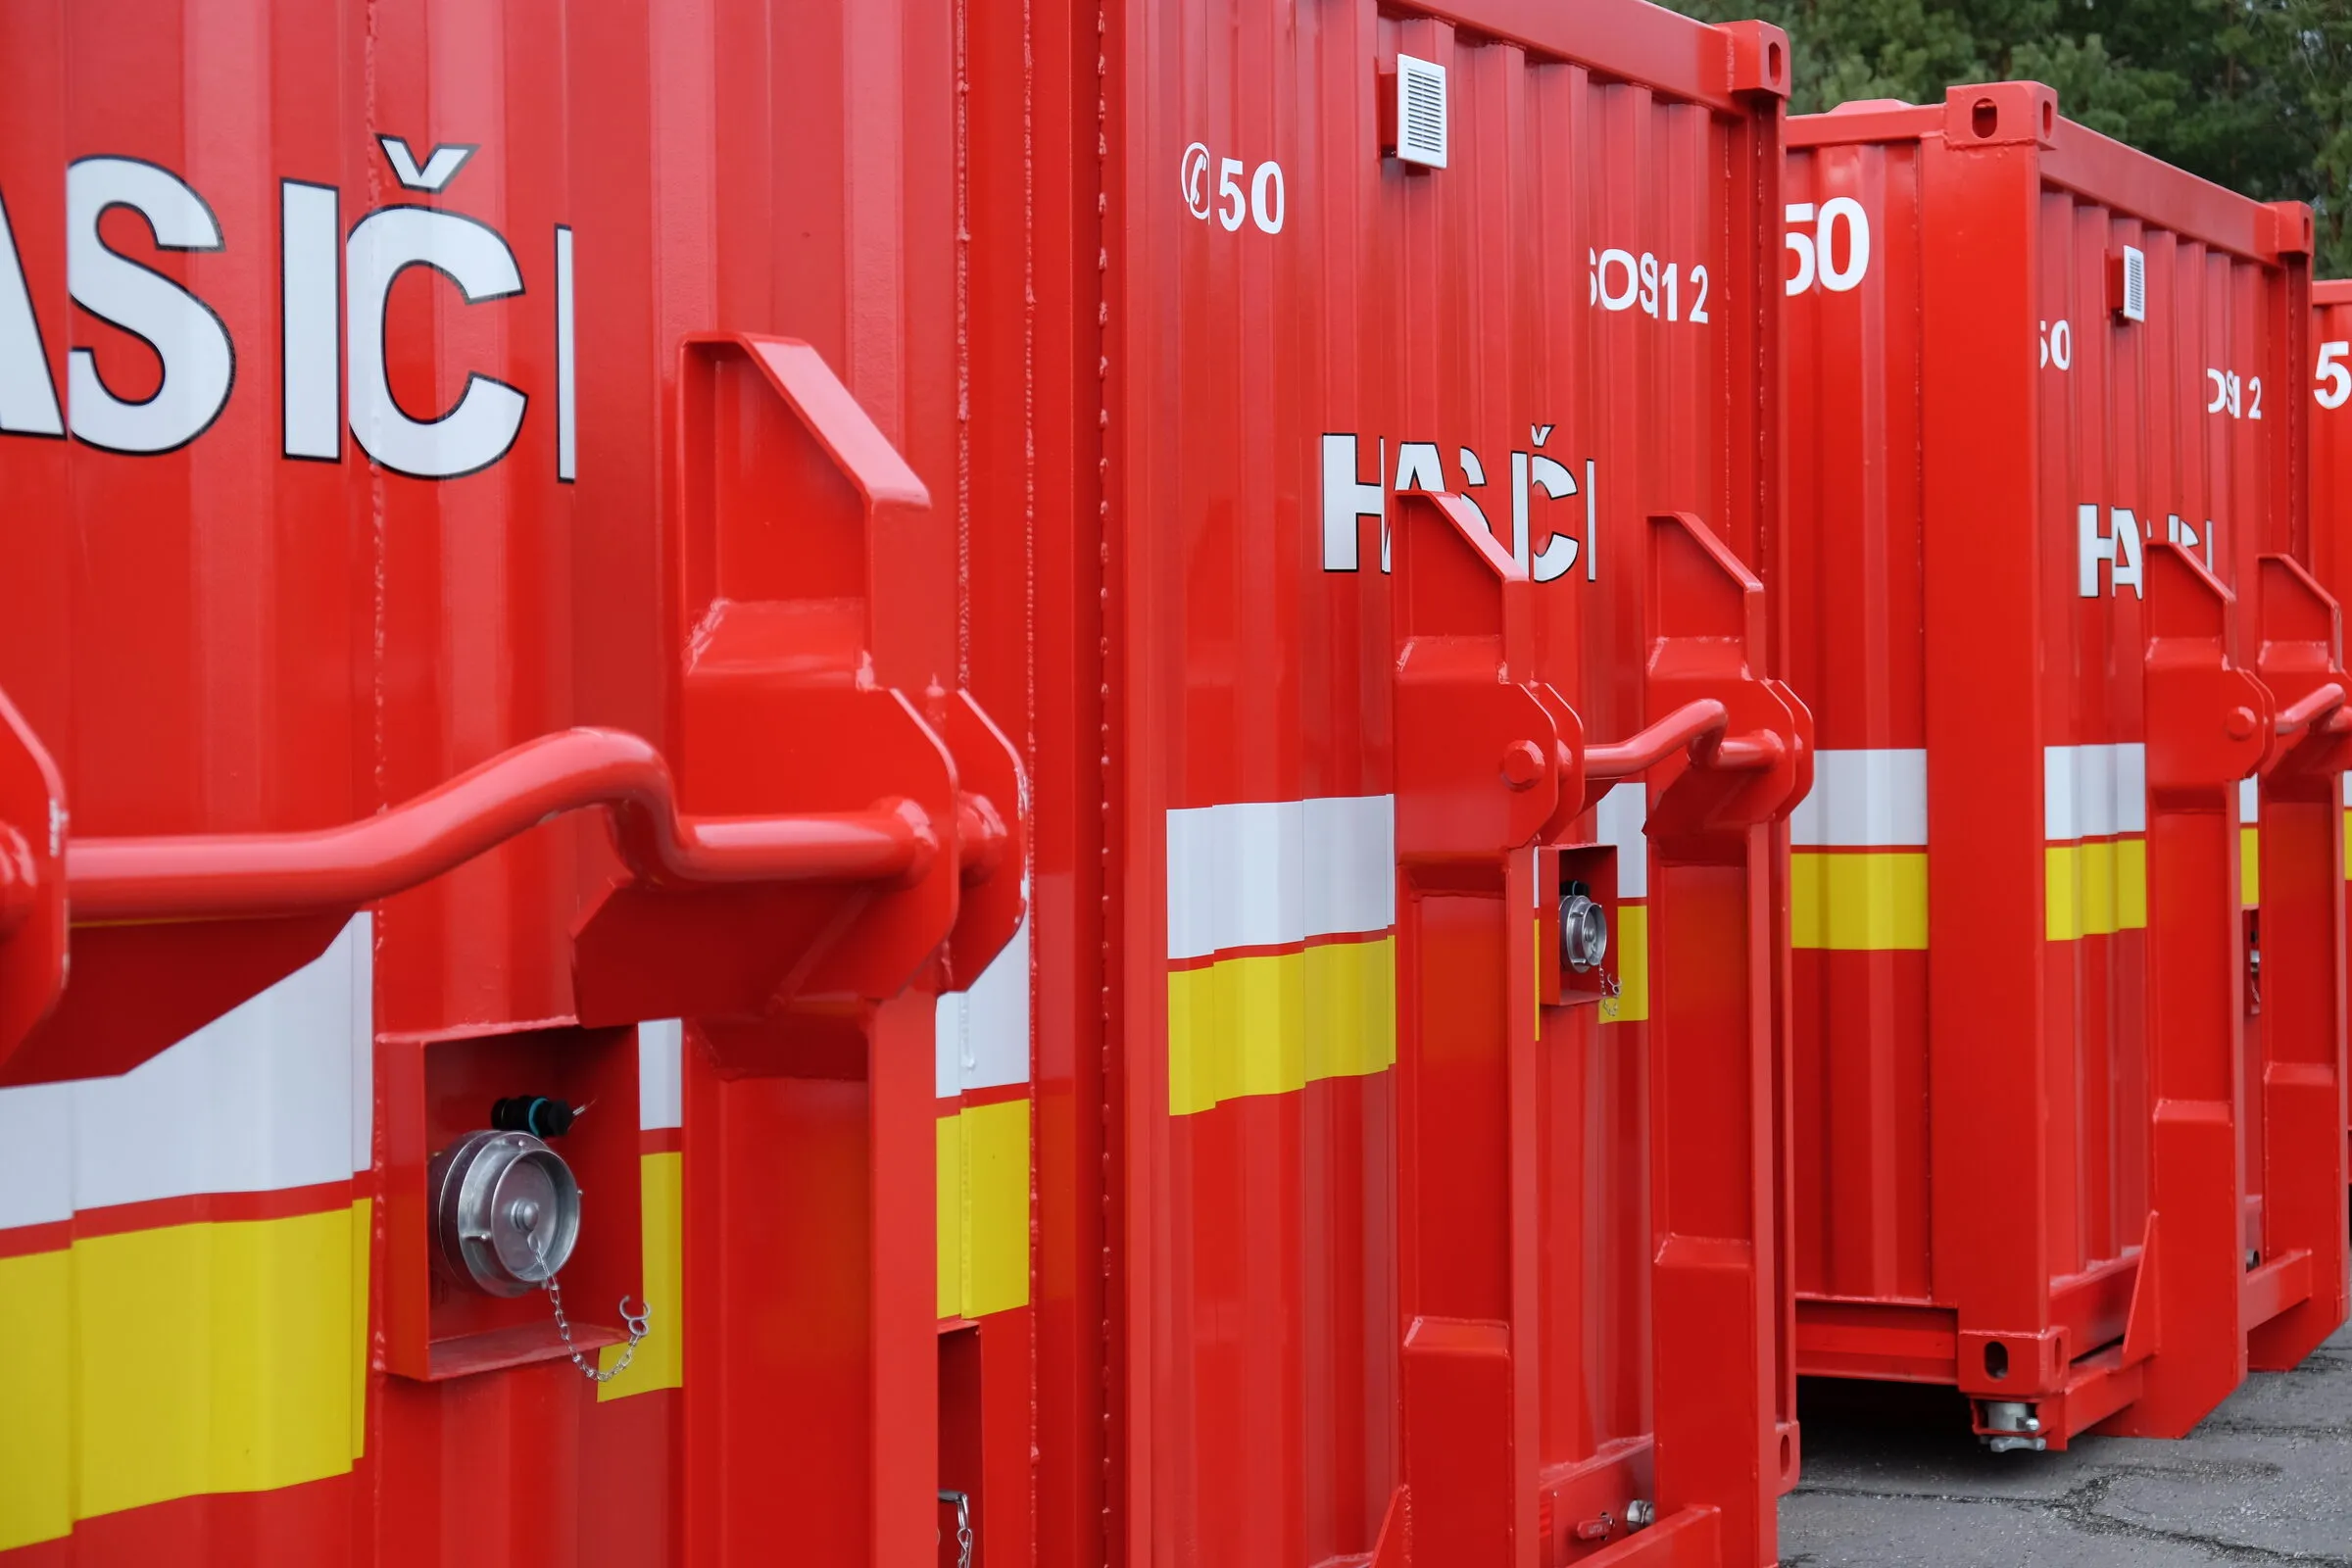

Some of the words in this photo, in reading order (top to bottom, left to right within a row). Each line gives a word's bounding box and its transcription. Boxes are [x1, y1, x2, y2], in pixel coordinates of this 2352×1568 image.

[1218, 157, 1285, 234] 50
[1785, 196, 1870, 297] 50
[0, 133, 576, 484] SIČI
[2313, 340, 2352, 411] 5
